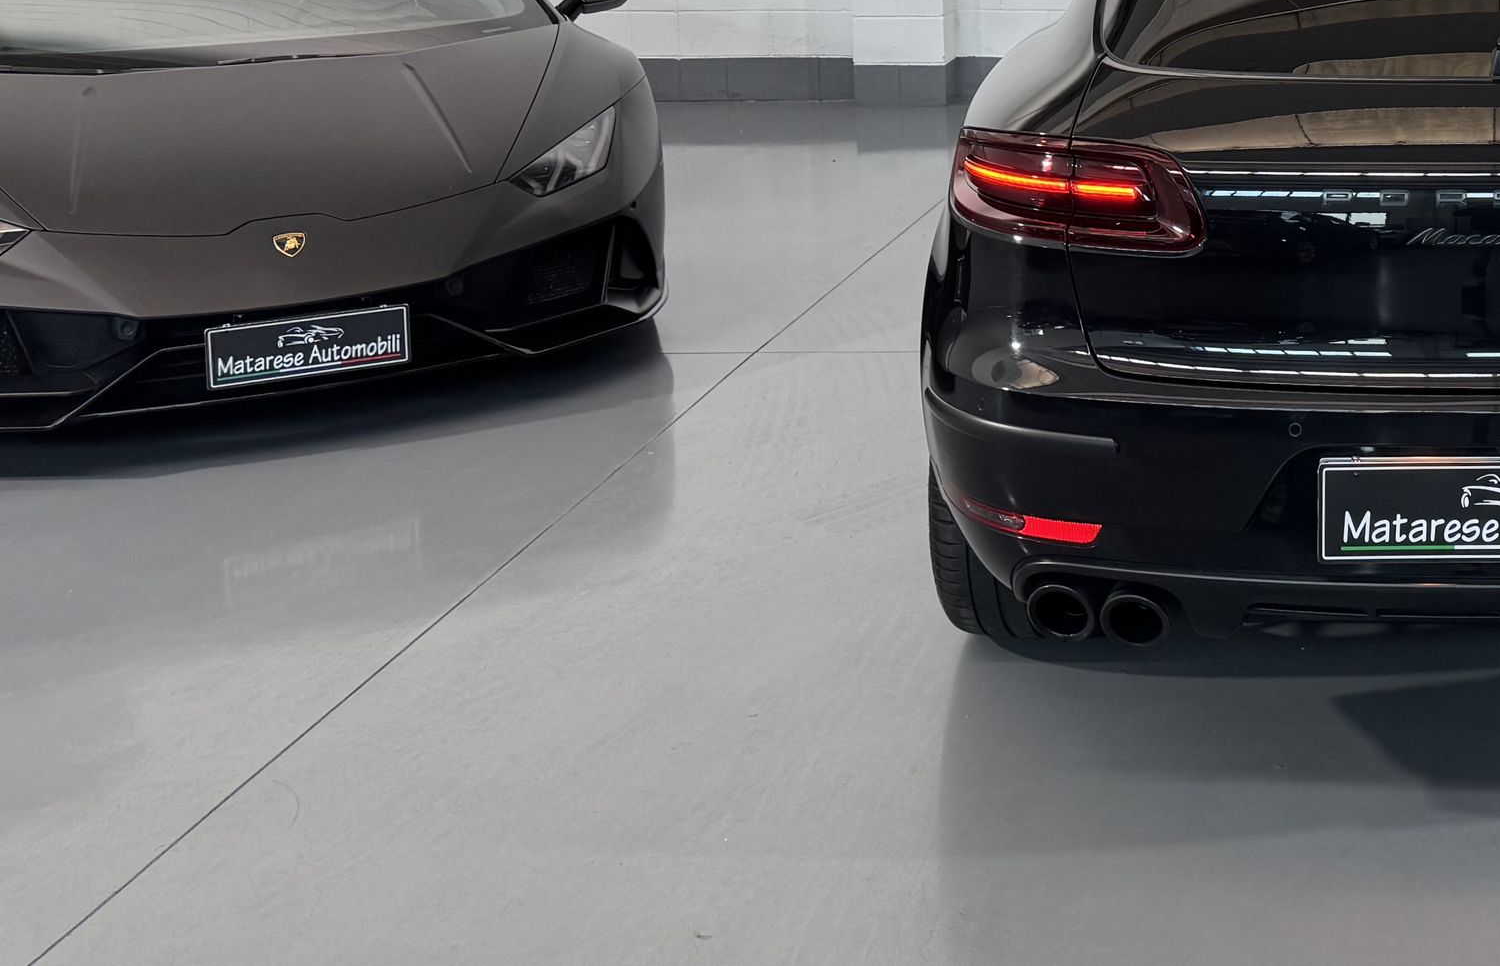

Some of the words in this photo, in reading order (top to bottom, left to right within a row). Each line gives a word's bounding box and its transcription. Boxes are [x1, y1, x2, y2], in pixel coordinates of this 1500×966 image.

[217, 354, 305, 377] Matarese
[309, 334, 401, 364] Automobili
[1343, 511, 1499, 543] Matarese
